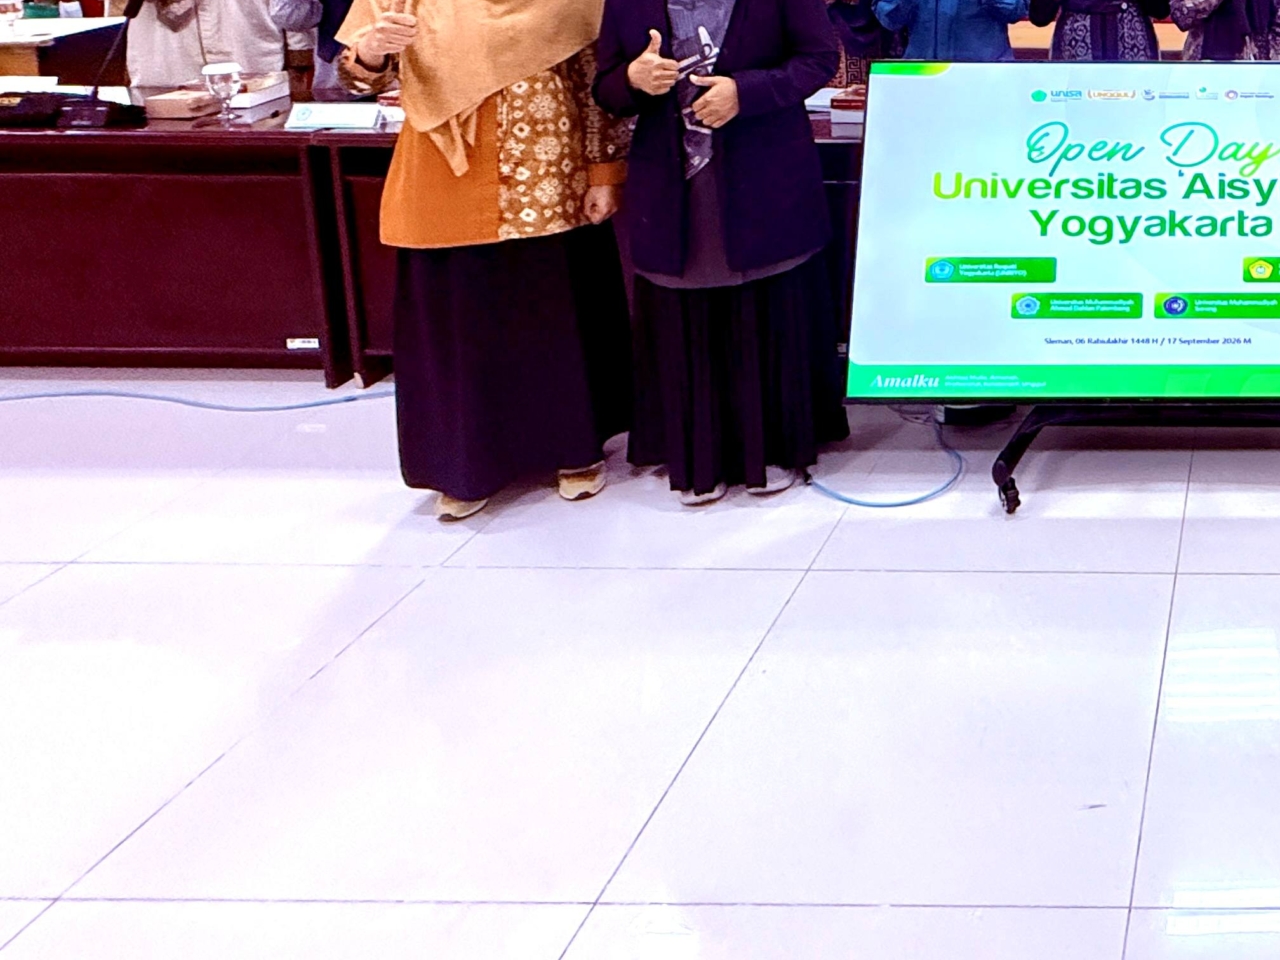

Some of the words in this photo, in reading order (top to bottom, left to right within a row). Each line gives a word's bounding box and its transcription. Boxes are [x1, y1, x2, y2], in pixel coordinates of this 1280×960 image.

[1026, 121, 1145, 175] Open
[932, 172, 1167, 200] Universitas
[1029, 210, 1273, 245] Yogyakarta
[1179, 338, 1220, 346] September
[870, 374, 939, 388] Amalku
